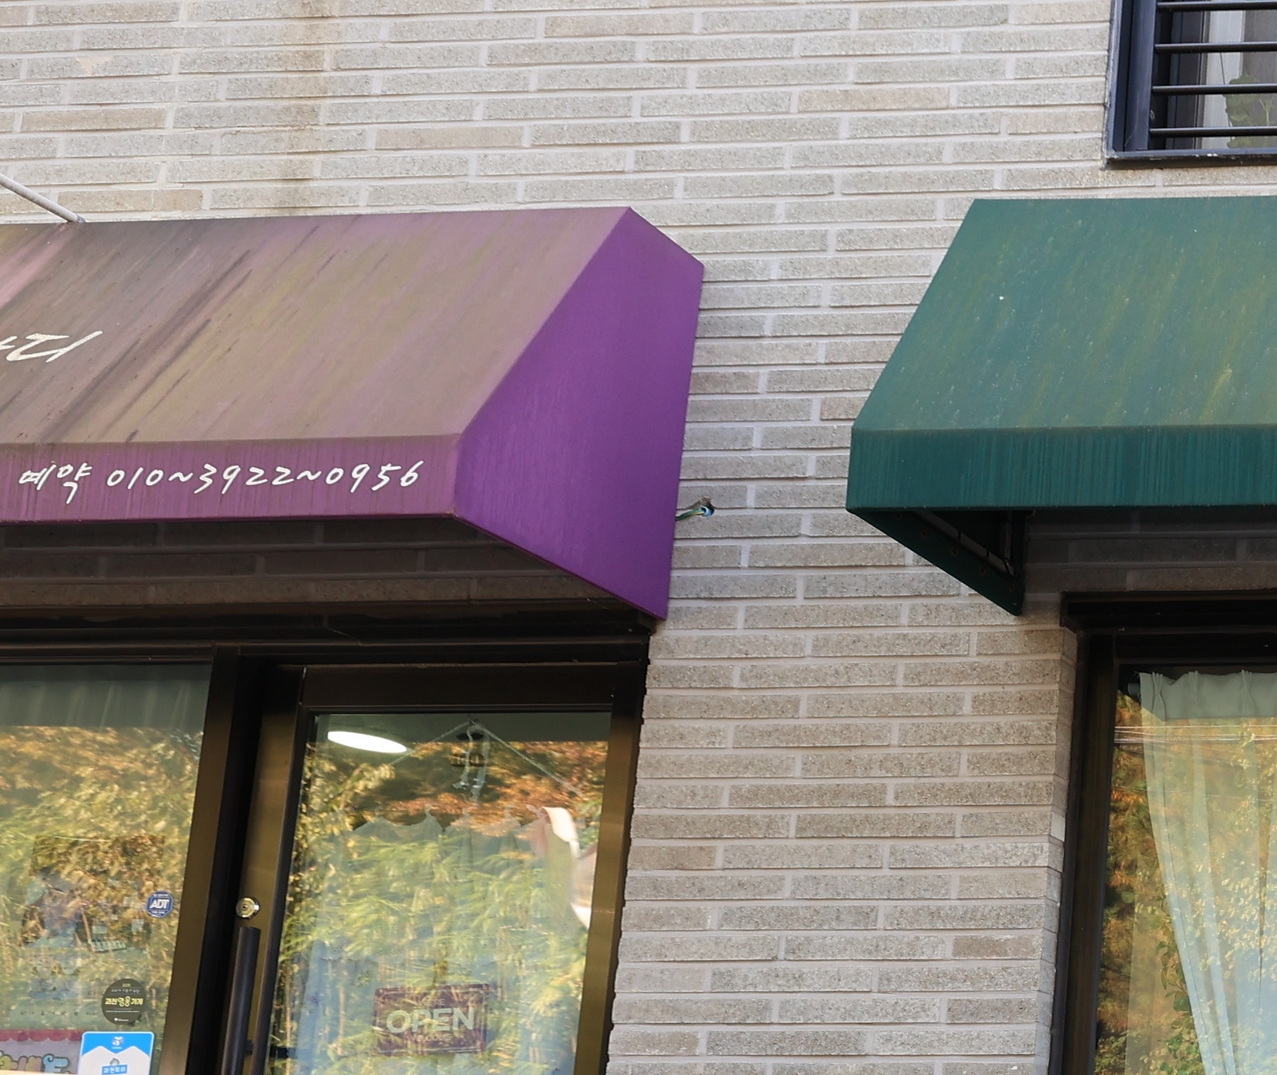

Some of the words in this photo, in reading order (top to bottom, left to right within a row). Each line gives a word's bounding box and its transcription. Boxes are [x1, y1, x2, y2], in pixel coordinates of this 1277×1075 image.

[18, 463, 93, 504] 예약
[150, 899, 170, 909] ADT
[386, 1007, 475, 1034] OPEN
